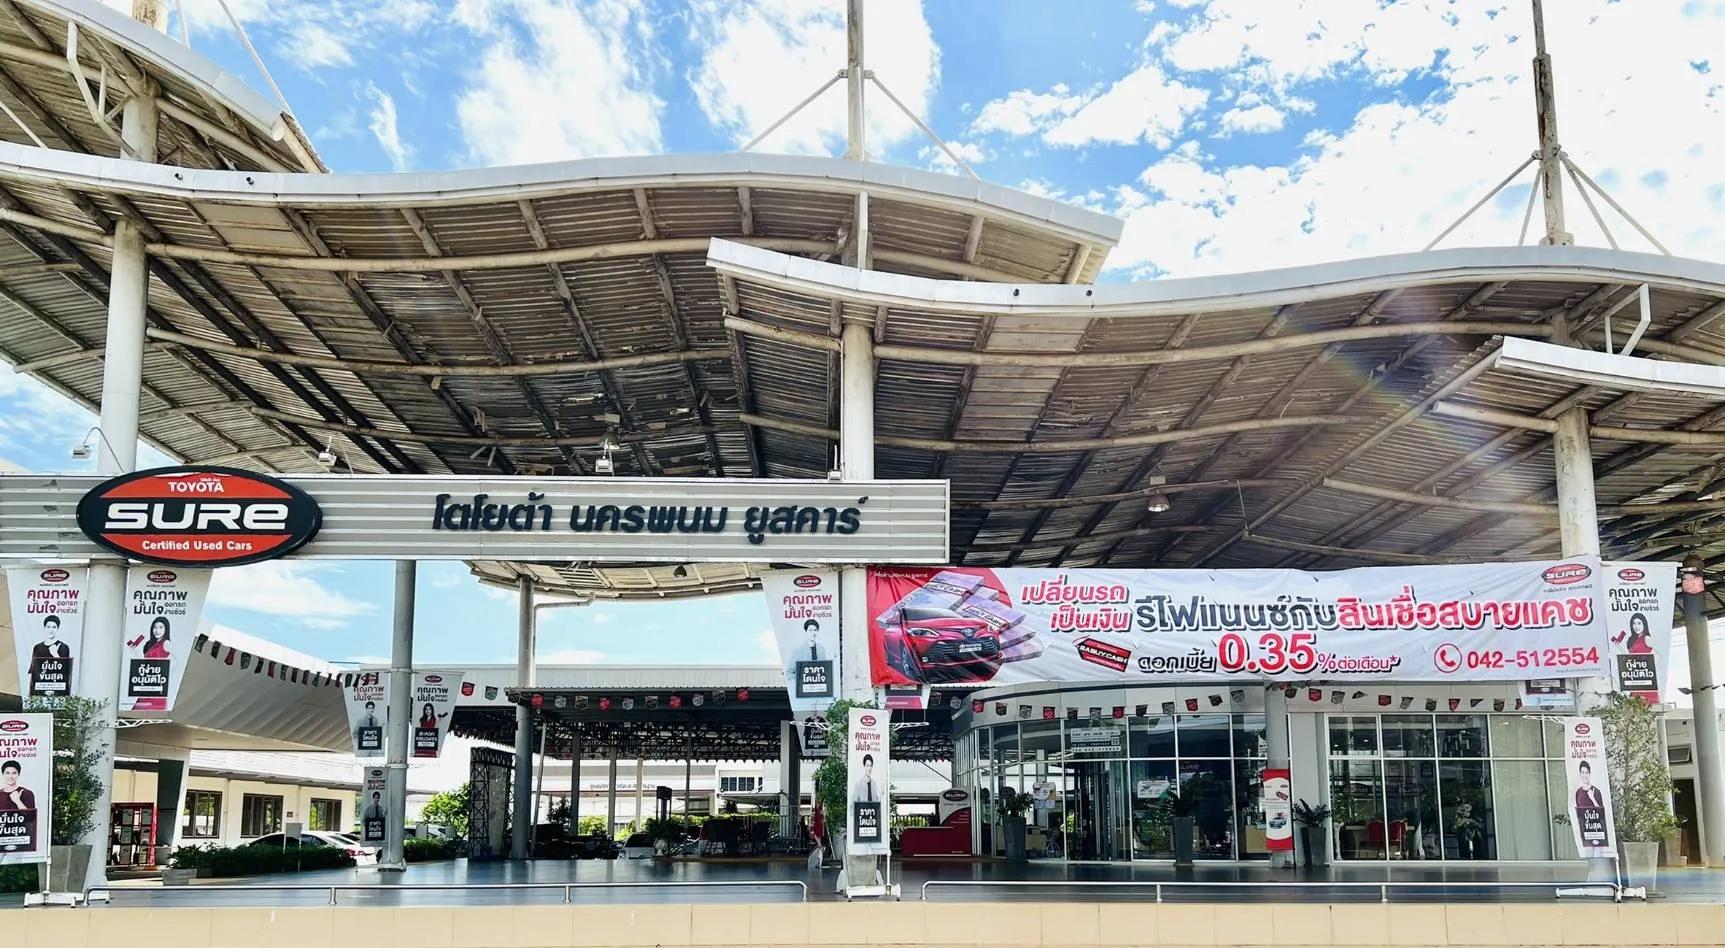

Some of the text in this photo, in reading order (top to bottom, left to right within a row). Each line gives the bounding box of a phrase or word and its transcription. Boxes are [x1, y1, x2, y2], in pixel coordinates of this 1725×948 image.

[168, 481, 224, 493] TOYOTA
[432, 492, 869, 545] โตโยต้า นครพนม ยูสคาร์
[142, 540, 252, 551] Certified Used Cars
[27, 589, 80, 601] คุณภาพ
[1021, 574, 1128, 604] เปลี่ยนรถ
[1608, 588, 1658, 600] คุณภาพ
[133, 590, 188, 602] คุณภาพ
[783, 594, 832, 607] คุณภาพ
[27, 600, 57, 613] มั่นใจ
[133, 601, 164, 615] มั่นใจ
[1611, 599, 1639, 611] มั่นใจ
[784, 605, 812, 619] มั่นใจ
[1050, 604, 1131, 632] เป็นเงิน
[1138, 648, 1217, 672] ดอกเบี้ย
[1217, 632, 1319, 673] 0.35
[1467, 646, 1600, 669] 042-512554
[138, 664, 161, 676] กู้ง่าย
[803, 666, 825, 674] ราคา
[1625, 659, 1648, 671] กู้ง่าย
[131, 674, 167, 686] อนุมัติไว
[803, 674, 826, 683] โดนใจ
[1621, 669, 1654, 680] อนุมัติไว
[417, 687, 449, 695] คุณภาพ
